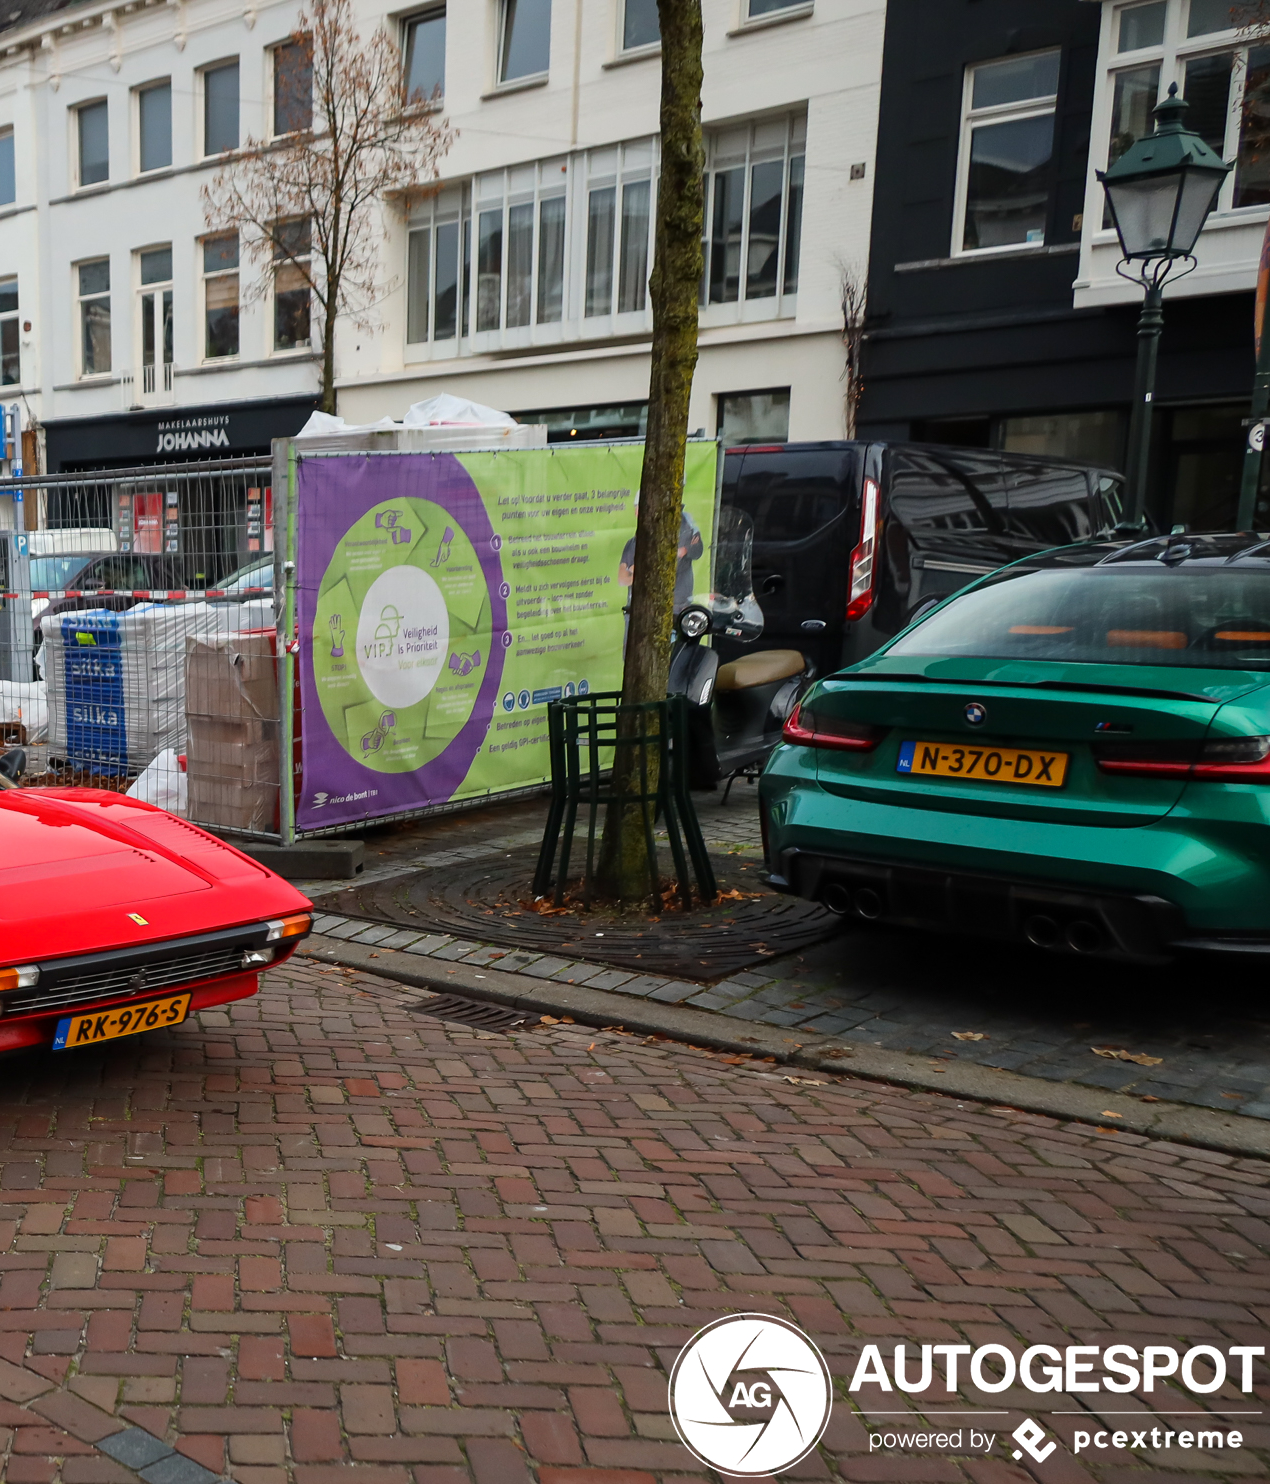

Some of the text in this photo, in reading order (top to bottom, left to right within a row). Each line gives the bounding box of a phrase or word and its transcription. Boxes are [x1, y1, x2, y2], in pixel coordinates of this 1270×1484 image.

[158, 416, 230, 430] MAKELAARSHUYS
[156, 428, 230, 453] JOHANNA
[498, 496, 509, 505] Let
[522, 494, 545, 504] Voordat
[552, 492, 572, 501] verder
[592, 490, 596, 499] 3
[597, 488, 631, 500] belangrijke
[502, 510, 526, 521] punten
[528, 510, 539, 518] voor
[552, 507, 569, 518] eigen
[579, 506, 593, 514] onze
[18, 536, 26, 552] P
[512, 549, 521, 557] als
[528, 546, 538, 555] ook
[540, 546, 550, 554] een
[516, 583, 532, 593] Meldt
[538, 582, 549, 591] zich
[550, 580, 580, 590] vervolgens
[576, 590, 594, 599] zonder
[403, 625, 438, 640] Veiligheid
[540, 630, 554, 641] goed
[555, 630, 562, 638] op
[563, 628, 569, 637] al
[570, 628, 578, 636] het
[398, 641, 438, 654] Is Prioriteit
[72, 658, 115, 677] silka
[398, 656, 438, 670] Voor elkaar
[73, 706, 118, 726] silka
[496, 716, 547, 731] Betreden op eigen
[489, 744, 500, 753] Een
[502, 740, 518, 752] geldig
[900, 746, 1056, 781] NL N-370-DX
[330, 796, 345, 804] nico
[346, 793, 354, 801] de
[354, 790, 368, 800] bont
[55, 1000, 182, 1045] NL RK-976-S
